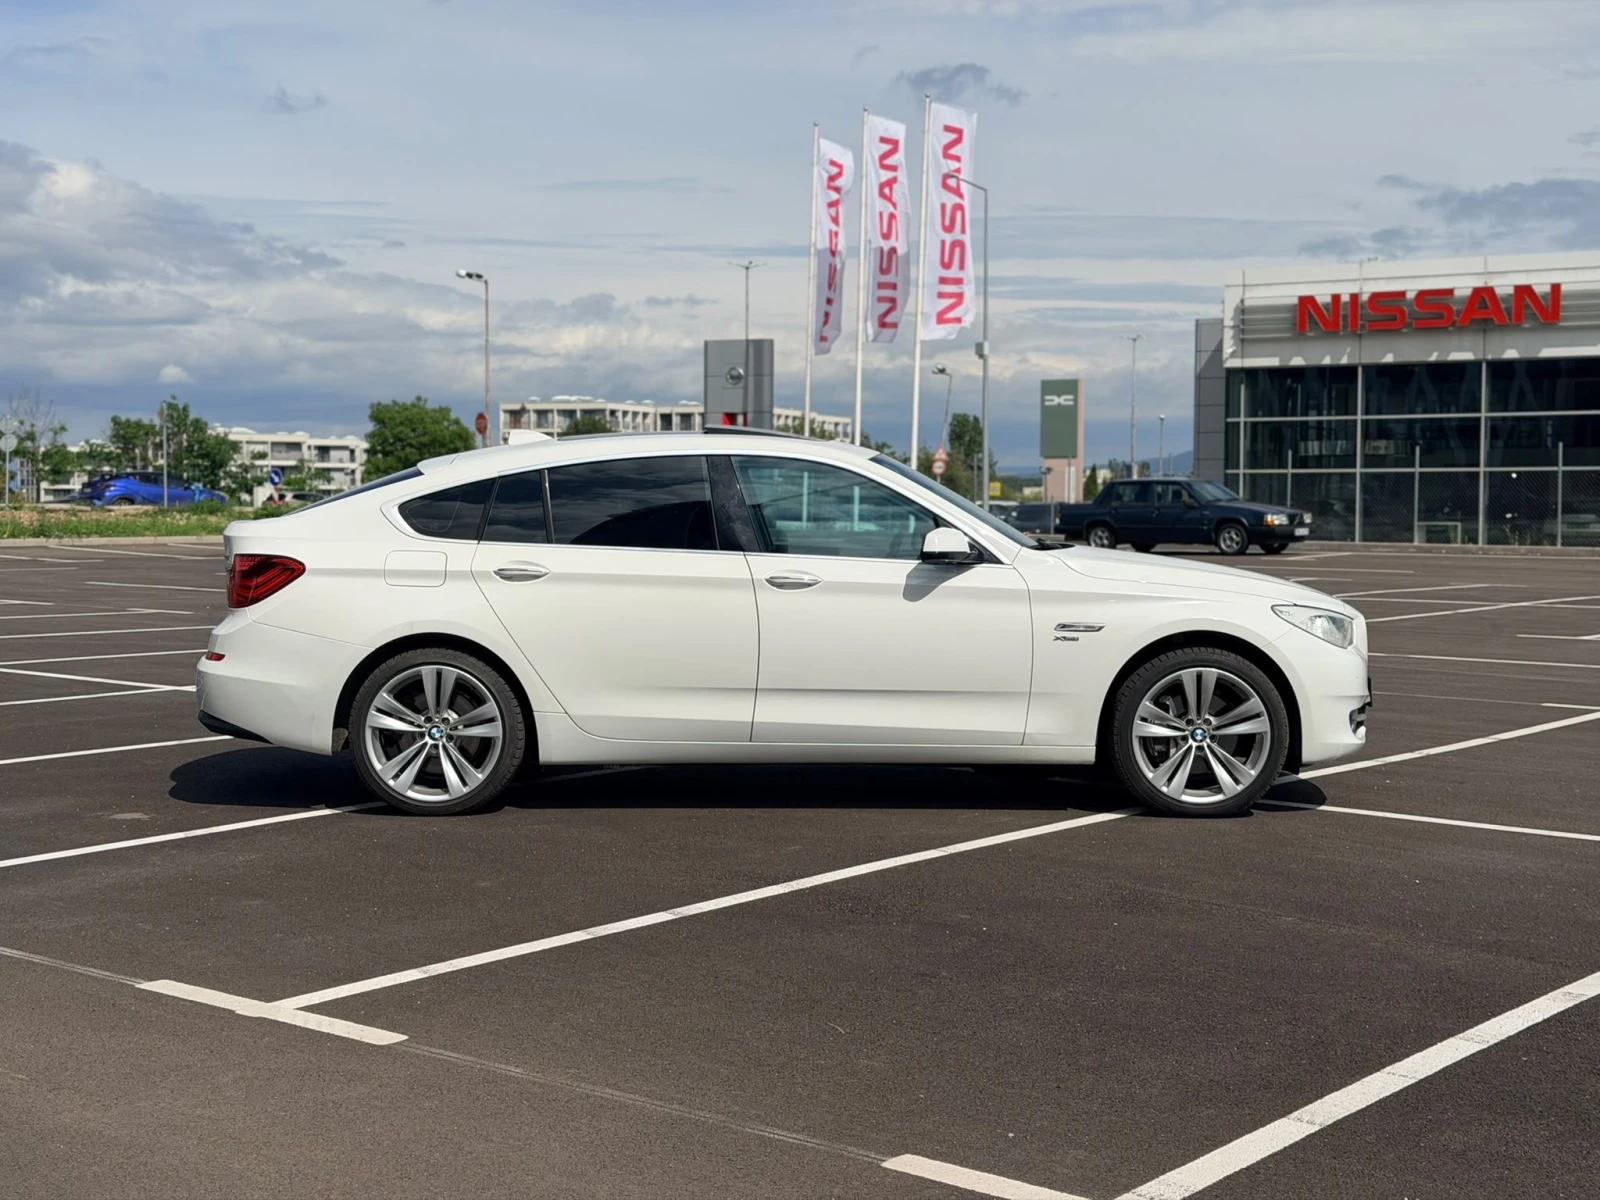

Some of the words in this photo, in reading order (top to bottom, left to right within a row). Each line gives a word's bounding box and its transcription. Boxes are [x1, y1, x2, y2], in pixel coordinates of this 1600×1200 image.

[877, 136, 900, 329] NISSAN
[936, 125, 967, 326] NISSAN
[1298, 283, 1562, 334] NISSAN
